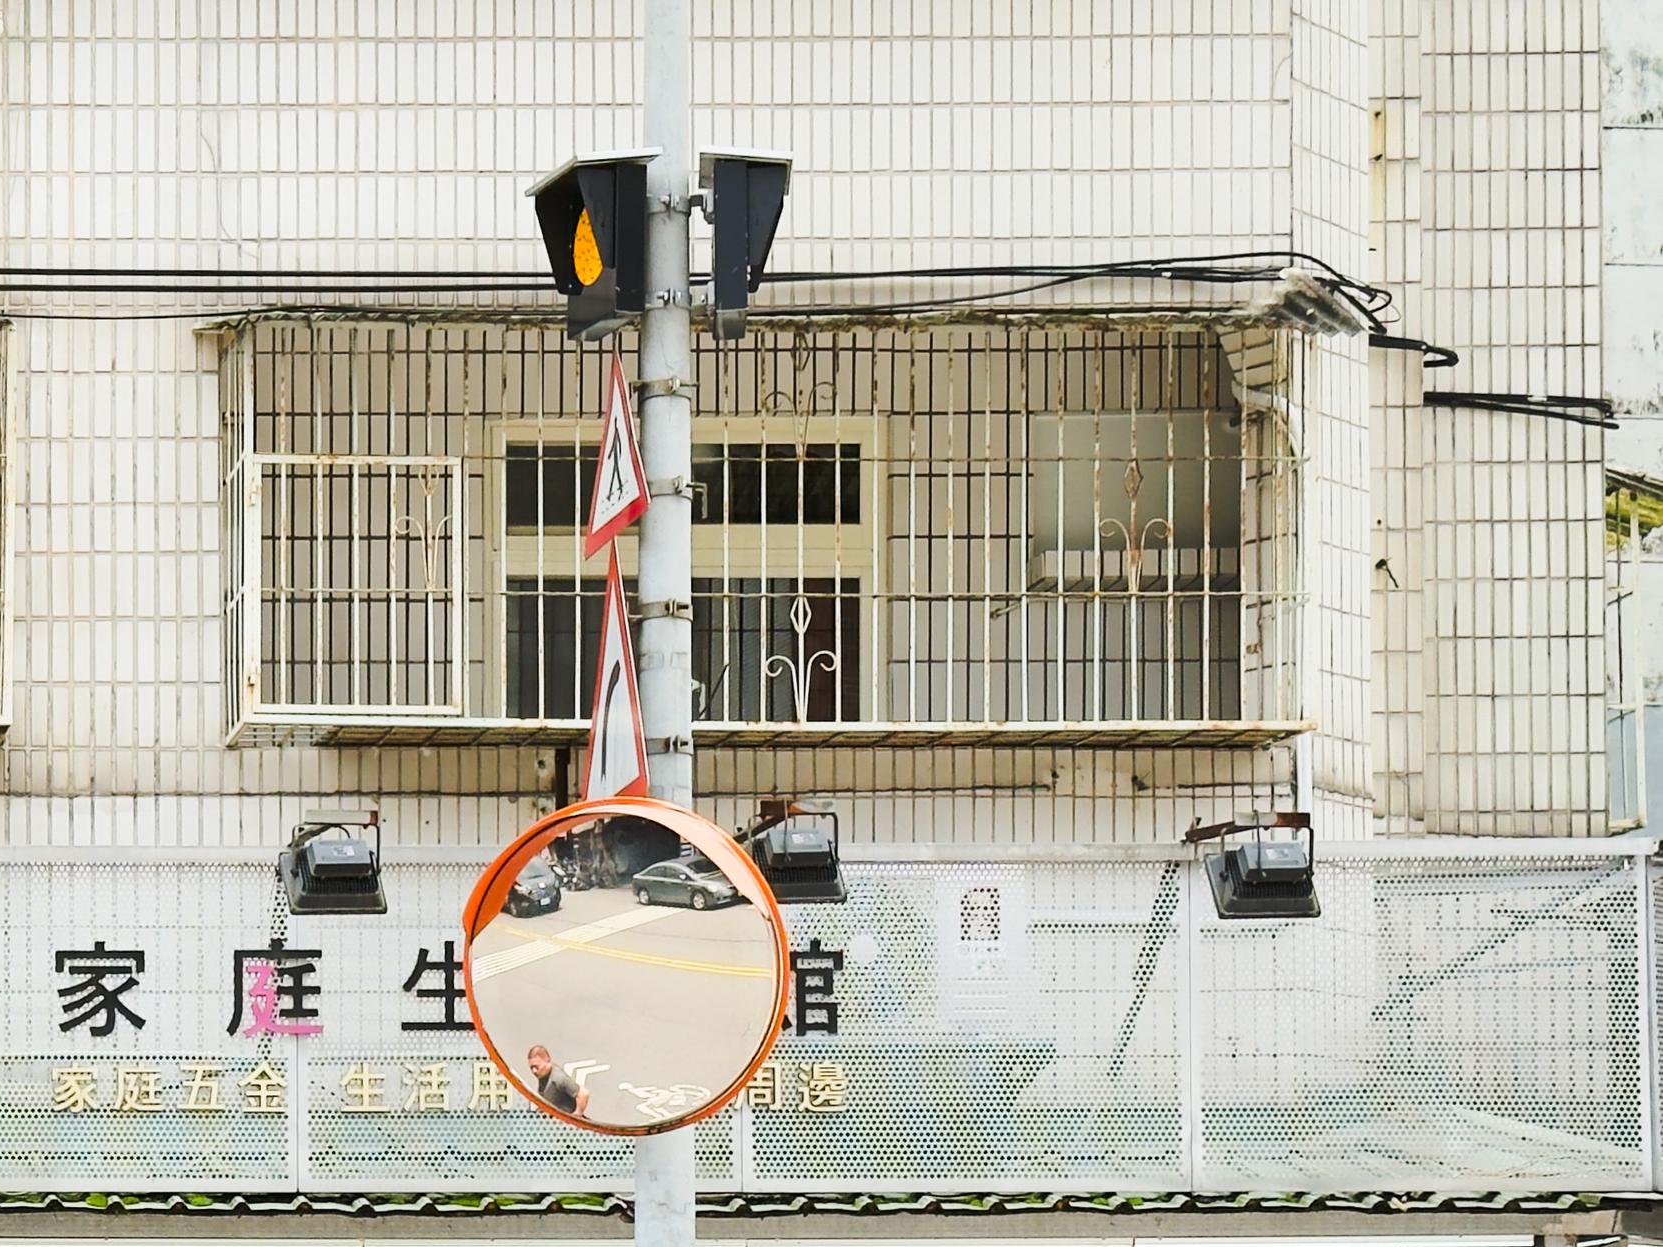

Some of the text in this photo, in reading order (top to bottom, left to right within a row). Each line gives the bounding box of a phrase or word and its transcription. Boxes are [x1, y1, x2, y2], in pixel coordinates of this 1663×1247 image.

[51, 1061, 287, 1114] 家庭五金
[339, 1061, 541, 1113] 生活用
